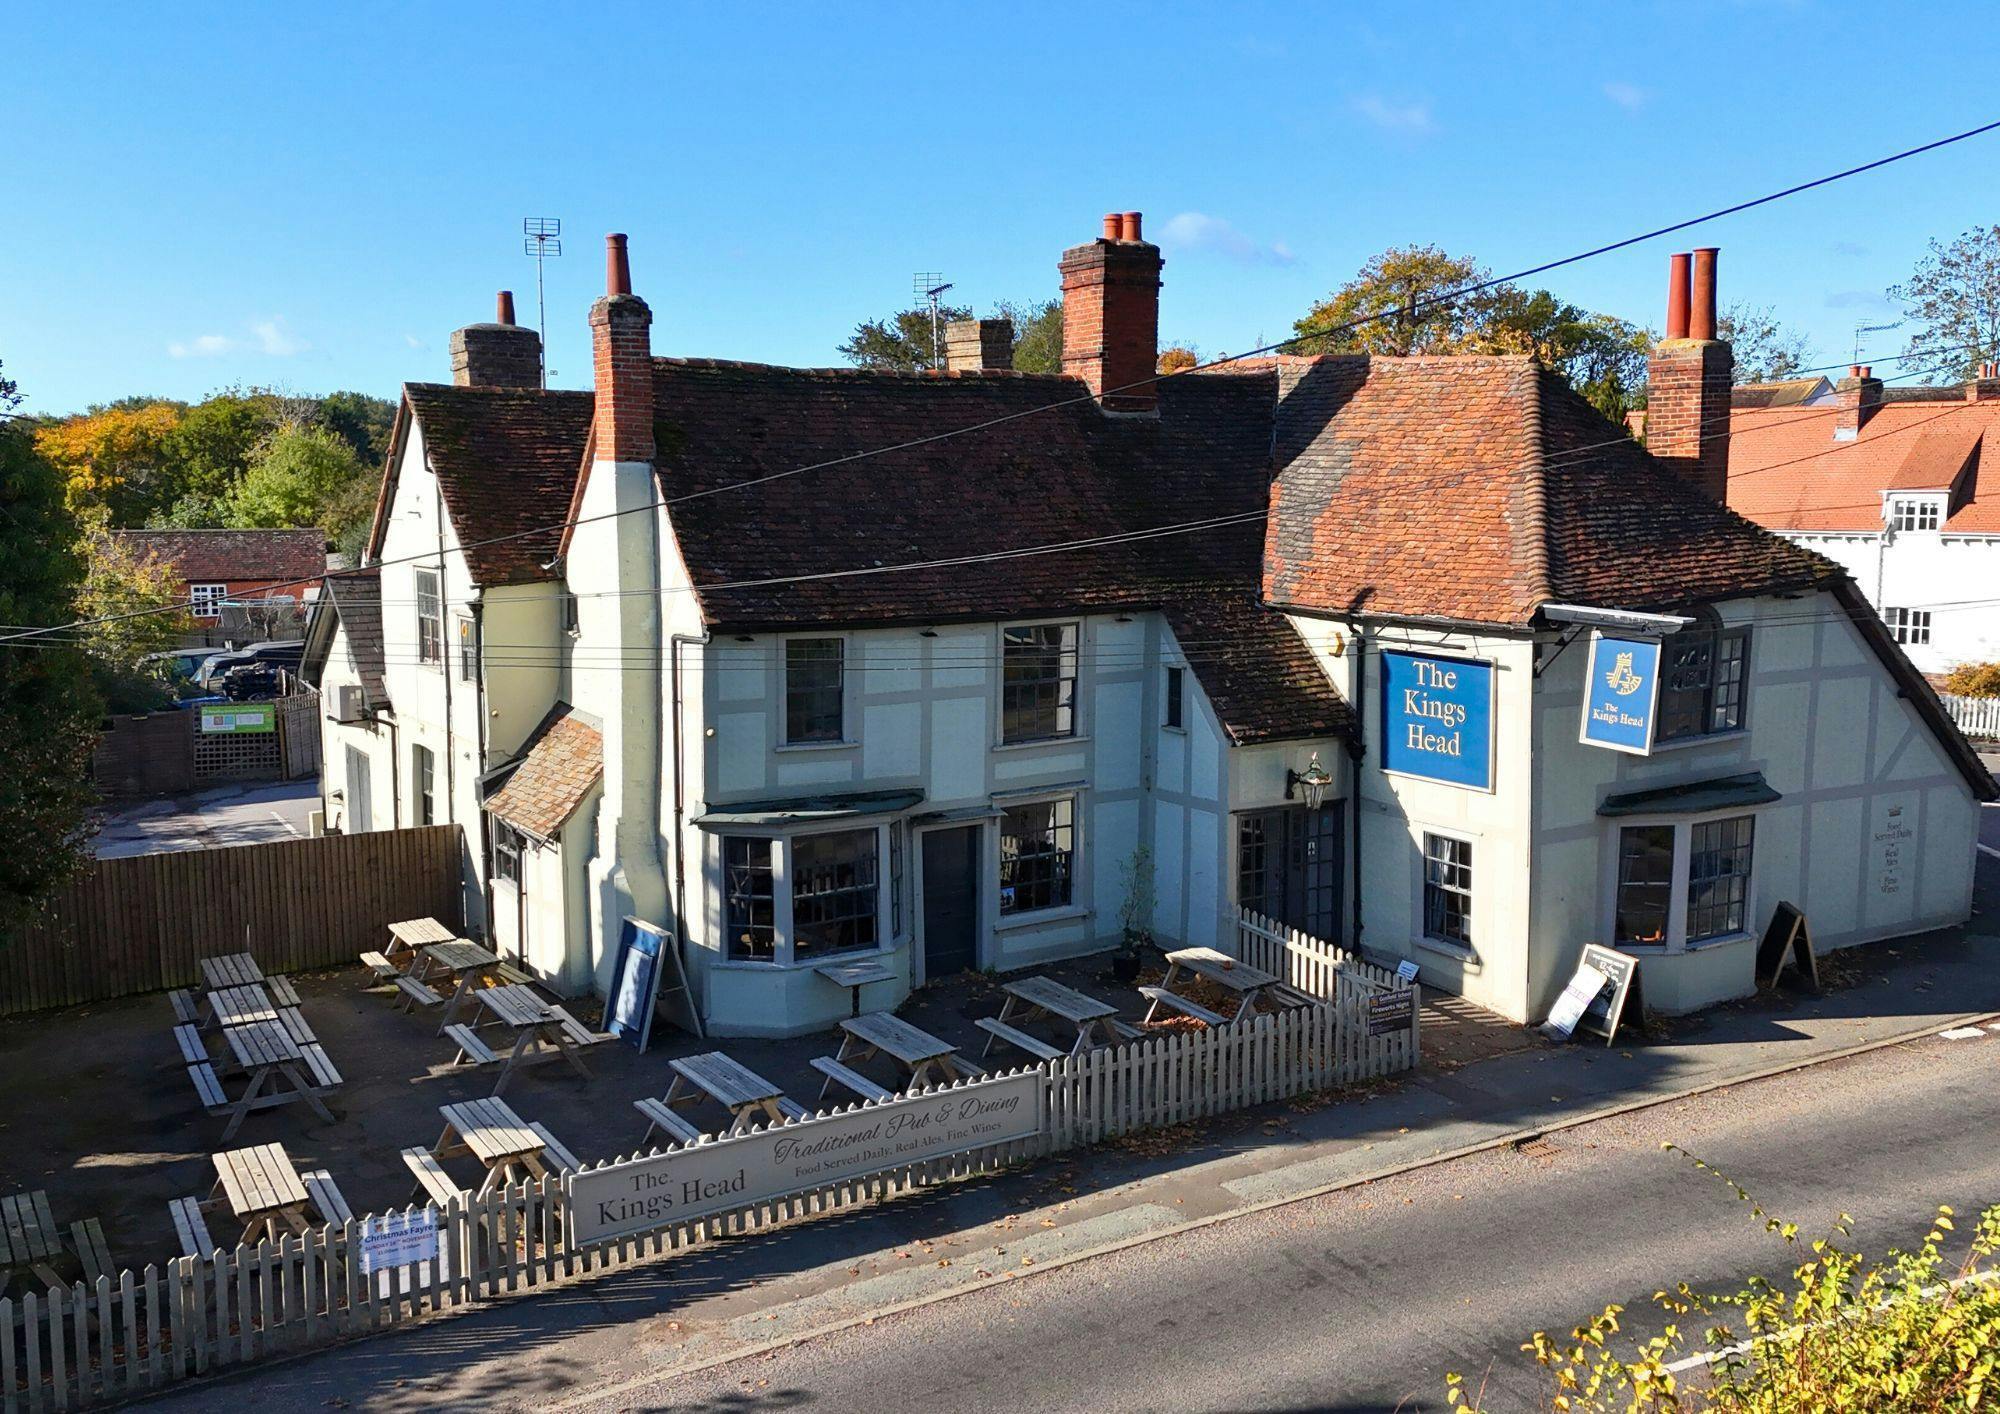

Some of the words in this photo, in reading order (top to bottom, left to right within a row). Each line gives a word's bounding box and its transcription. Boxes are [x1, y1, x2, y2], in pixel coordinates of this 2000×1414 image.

[1412, 660, 1457, 689] The
[1604, 702, 1619, 712] The
[1619, 713, 1644, 728] Head
[1406, 723, 1462, 756] Head
[774, 1122, 881, 1165] Traditional
[885, 1112, 931, 1139] Pub
[935, 1102, 954, 1124] &
[958, 1096, 1020, 1120] Dining
[795, 1162, 821, 1177] Food
[823, 1155, 860, 1170] Served
[895, 1139, 918, 1153] Real
[947, 1128, 968, 1141] Fine
[970, 1122, 1002, 1134] Wines
[629, 1172, 668, 1192] The
[681, 1169, 746, 1205] Head
[364, 1229, 409, 1243] Christmas
[410, 1224, 433, 1235] Fayre
